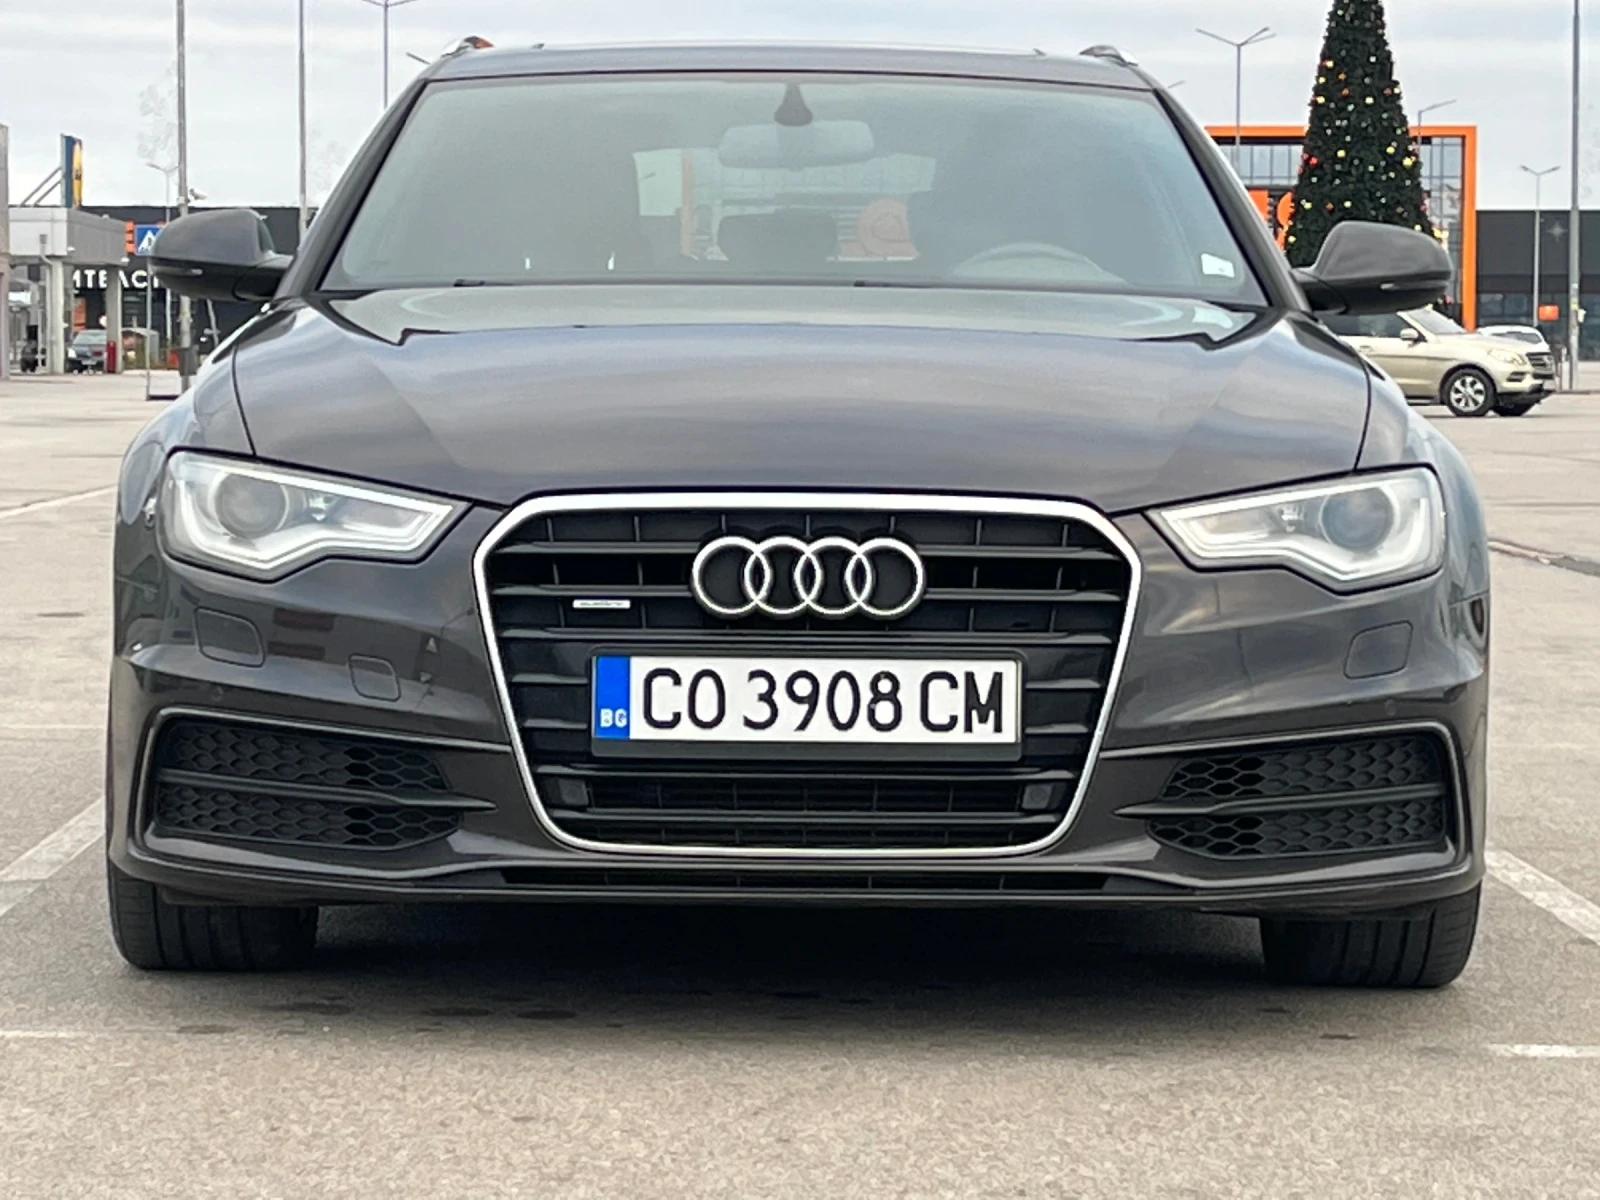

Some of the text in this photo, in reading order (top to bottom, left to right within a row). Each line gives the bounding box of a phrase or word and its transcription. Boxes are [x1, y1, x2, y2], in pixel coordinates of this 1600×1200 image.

[600, 708, 627, 728] BG
[644, 668, 1003, 733] CO 3908 CM
